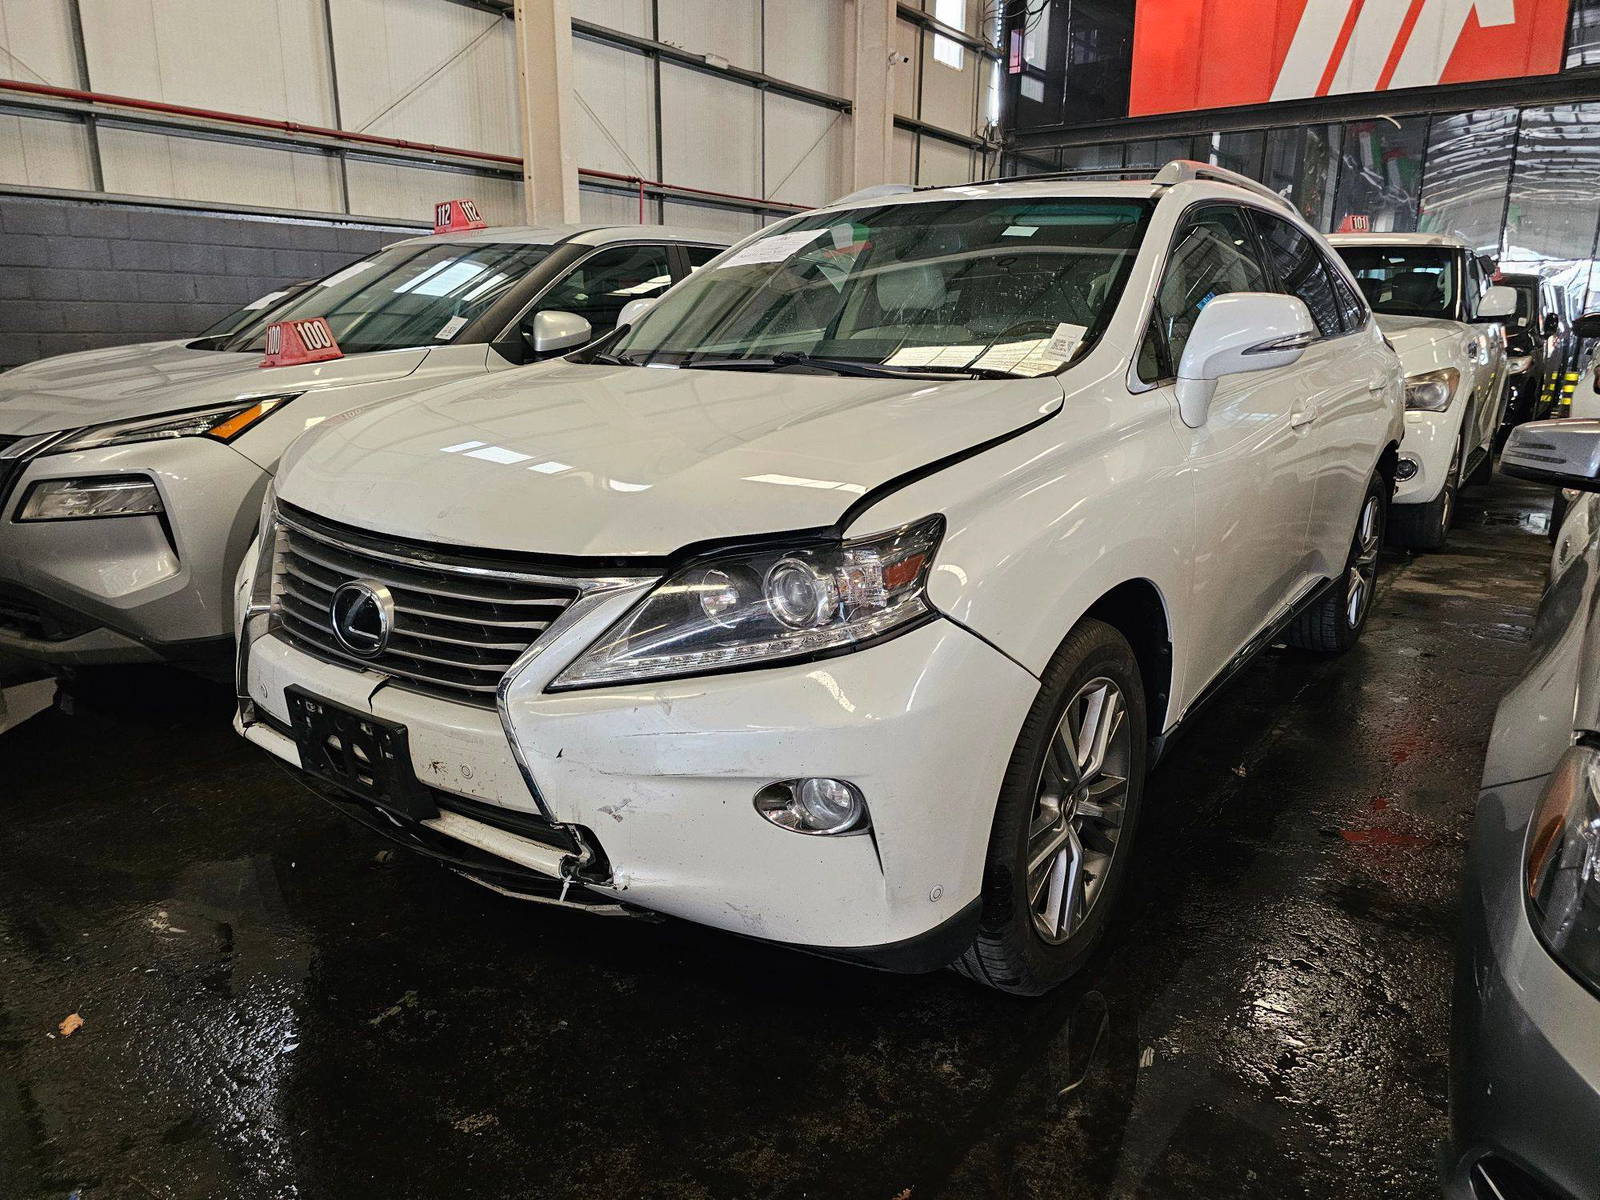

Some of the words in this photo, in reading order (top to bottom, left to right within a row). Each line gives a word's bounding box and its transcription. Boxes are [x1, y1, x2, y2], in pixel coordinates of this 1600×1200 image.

[438, 203, 450, 226] 112
[462, 201, 480, 222] 112
[1352, 216, 1367, 229] 101
[268, 326, 281, 355] 100
[297, 320, 332, 350] 100
